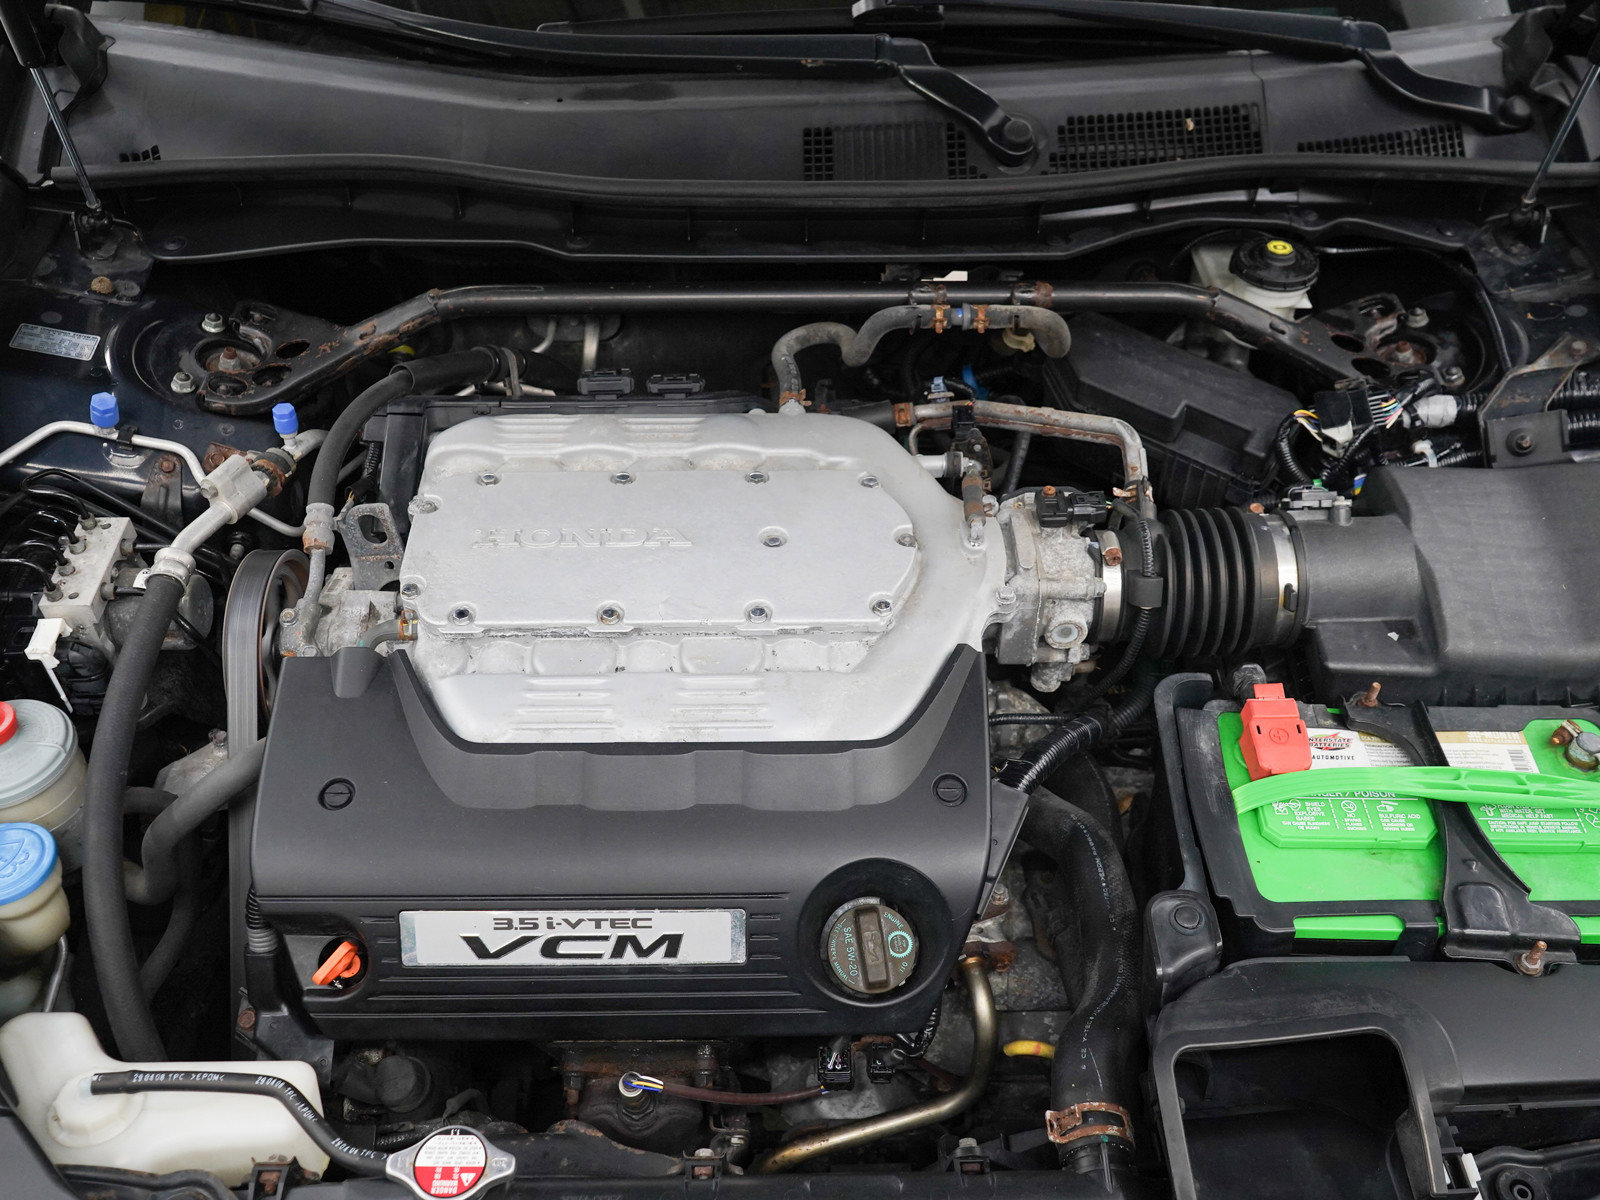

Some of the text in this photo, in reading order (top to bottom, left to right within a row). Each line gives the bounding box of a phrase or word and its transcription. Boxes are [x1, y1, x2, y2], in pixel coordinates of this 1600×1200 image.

[472, 528, 692, 548] HONDA
[493, 916, 653, 930] 3.5 i-VTEC
[884, 912, 904, 928] ENGINE
[459, 933, 684, 960] VCM
[844, 927, 858, 976] SAE 5W-20
[834, 962, 848, 981] MANUAL
